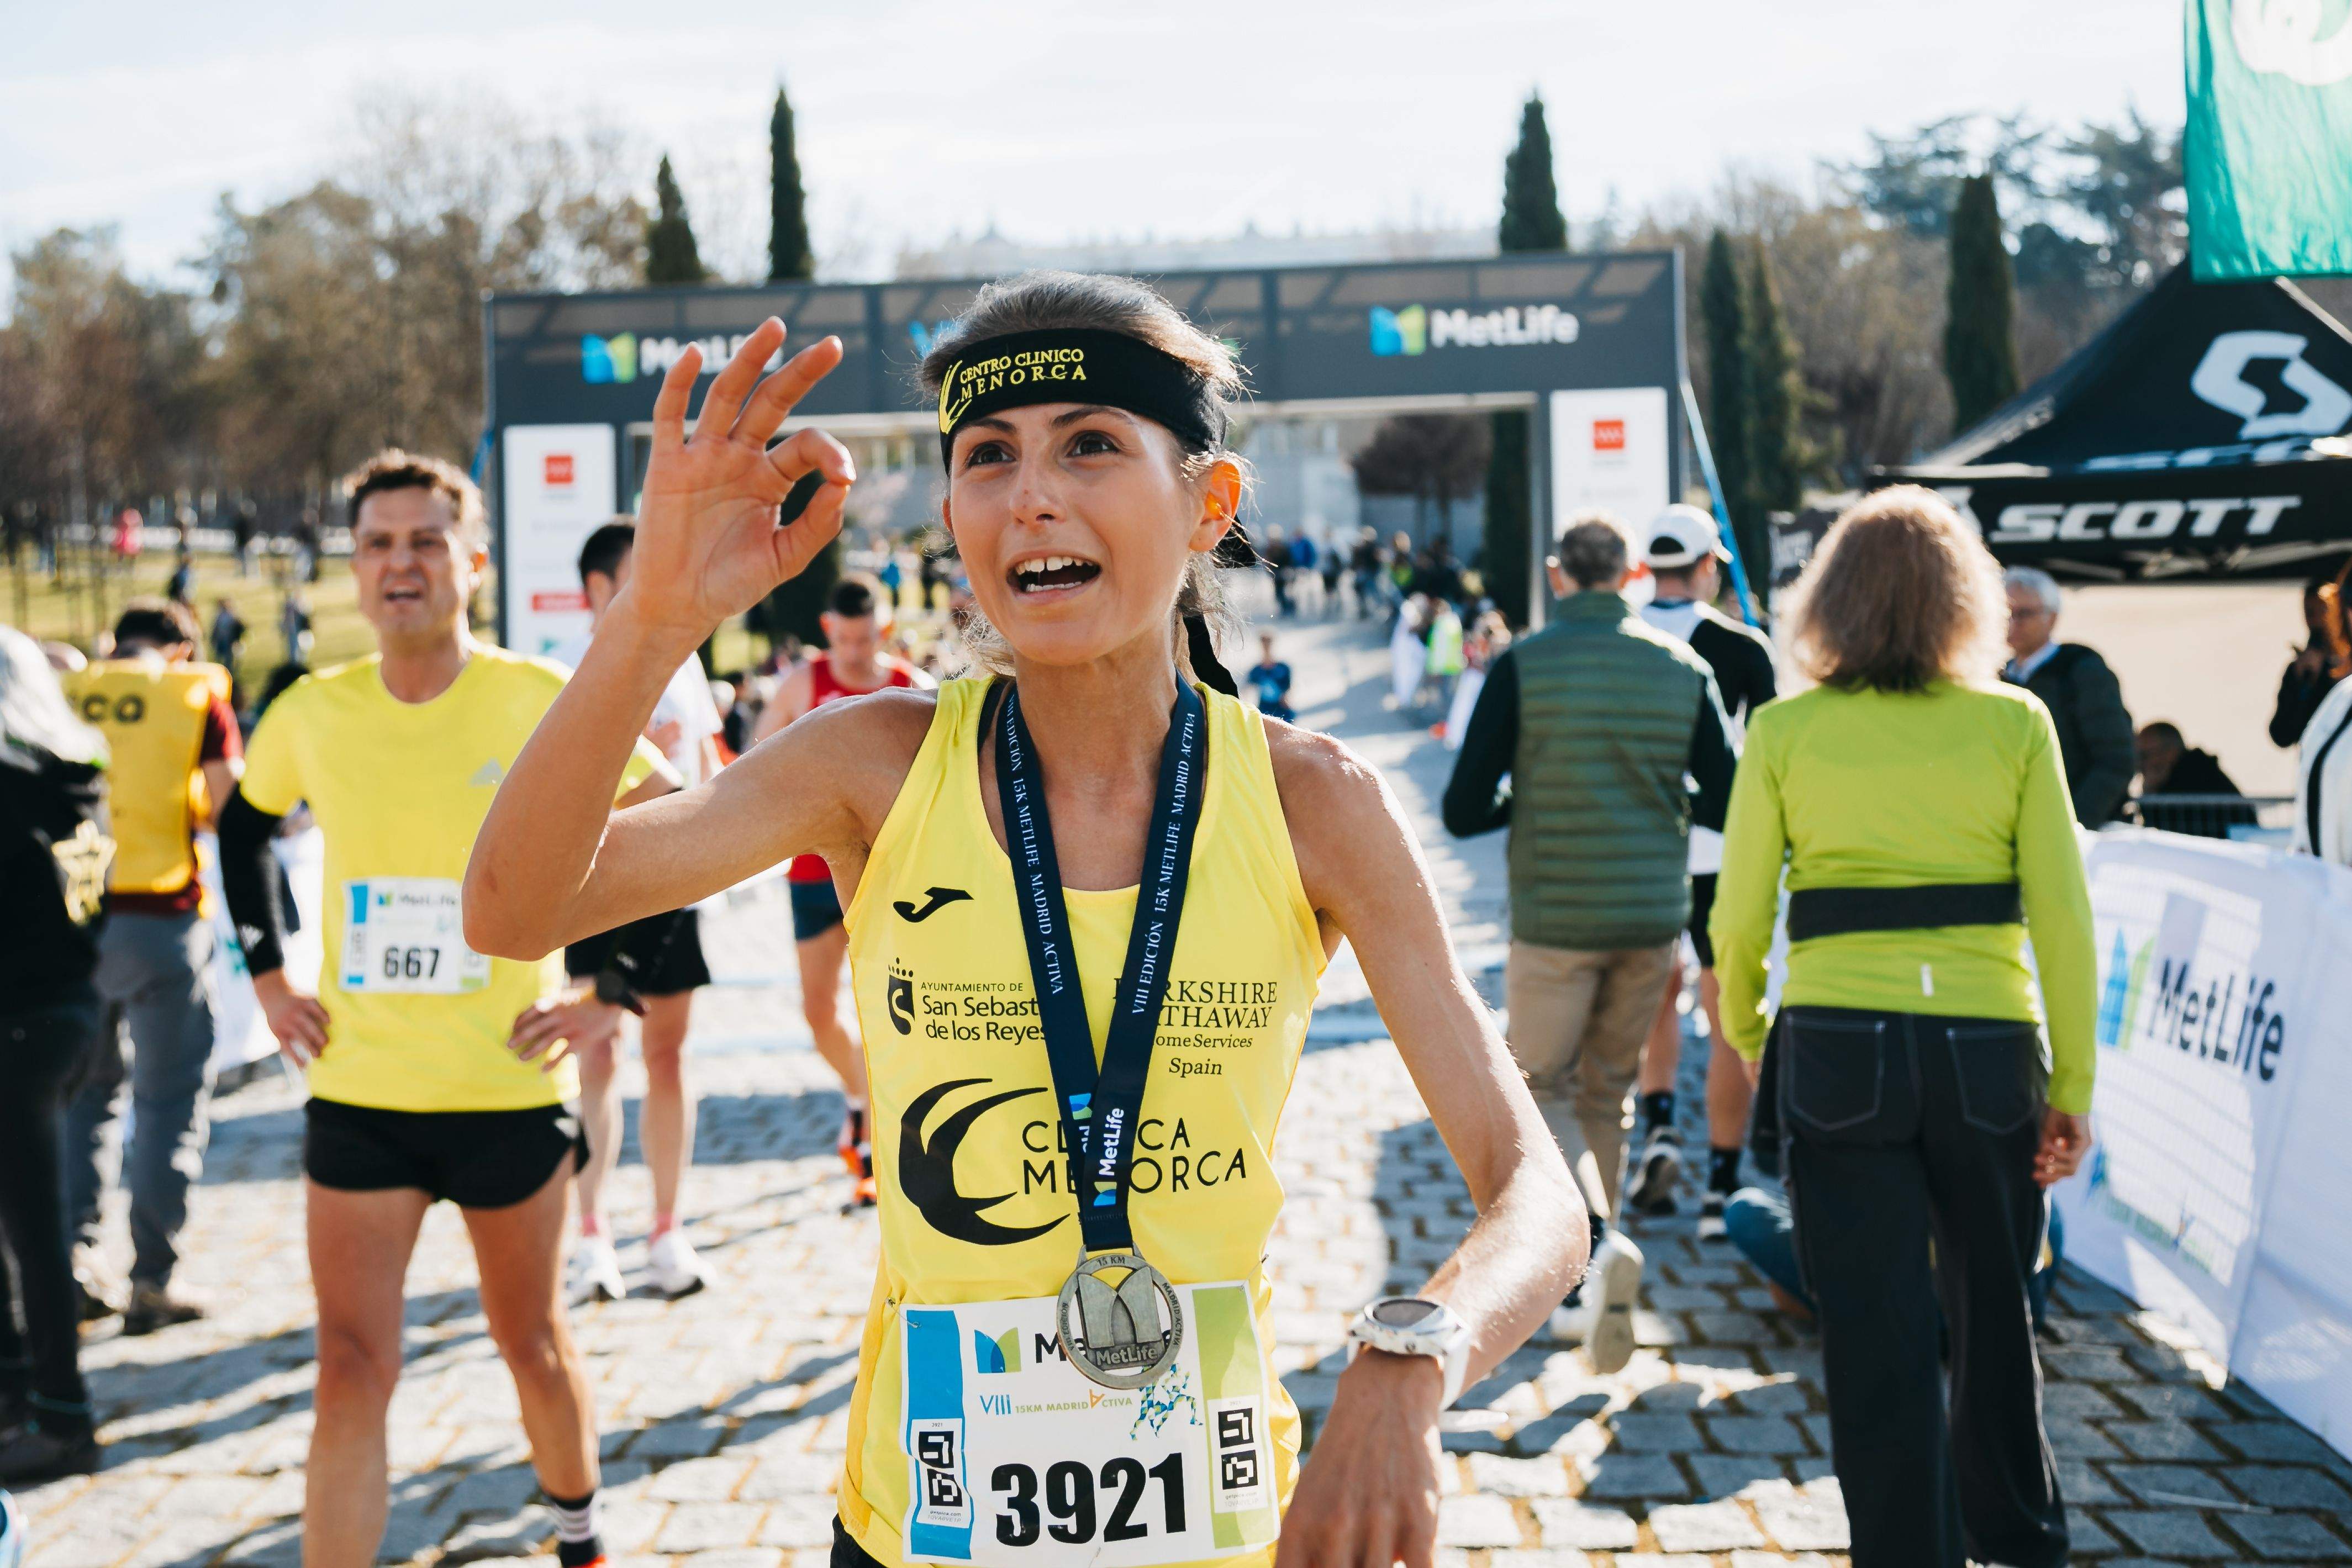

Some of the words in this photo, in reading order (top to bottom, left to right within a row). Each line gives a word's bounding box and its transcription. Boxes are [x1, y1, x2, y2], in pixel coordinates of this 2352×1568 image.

[1431, 304, 1579, 348] MetLife
[959, 356, 1011, 384] CENTRO
[1015, 349, 1084, 367] CLINICO
[960, 364, 1087, 402] MENORCA
[1990, 495, 2302, 543] SCOTT
[1006, 693, 1015, 717] VIII
[1006, 717, 1025, 772] EDICIÓN
[1181, 712, 1195, 758] ACTIVA
[1012, 778, 1028, 803] 15K
[1170, 760, 1190, 816] MADRID
[1017, 805, 1040, 867] METLIFE
[1159, 821, 1181, 884] METLIFE
[1030, 873, 1052, 935] MADRID
[1154, 886, 1170, 912] 15K
[384, 946, 441, 979] 667
[1042, 941, 1064, 995] ACTIVA
[1139, 921, 1164, 985] EDICIÓN
[921, 981, 1006, 992] AYUNTAMIENTO
[1010, 983, 1024, 992] DE
[1132, 988, 1149, 1014] VIII
[922, 995, 958, 1017] San
[964, 995, 1040, 1017] Sebast
[1157, 1005, 1273, 1028] THAWAY
[2147, 958, 2285, 1081] MetLife
[925, 1019, 949, 1040] de
[952, 1020, 980, 1041] los
[1156, 1033, 1253, 1048] omeServices
[1168, 1057, 1222, 1079] Spain
[1022, 1117, 1191, 1154] CLCA
[1099, 1107, 1125, 1176] MetLife
[1022, 1148, 1247, 1195] MEORCA
[1096, 1256, 1108, 1266] 15
[1110, 1256, 1126, 1264] KM
[1162, 1282, 1180, 1315] MADRID
[1172, 1316, 1183, 1347] ACTIVA
[1095, 1345, 1158, 1366] MetLife
[979, 1393, 1012, 1416] VIII
[1015, 1405, 1042, 1414] 15KM
[1046, 1401, 1088, 1412] MADRID
[991, 1452, 1186, 1547] 3921
